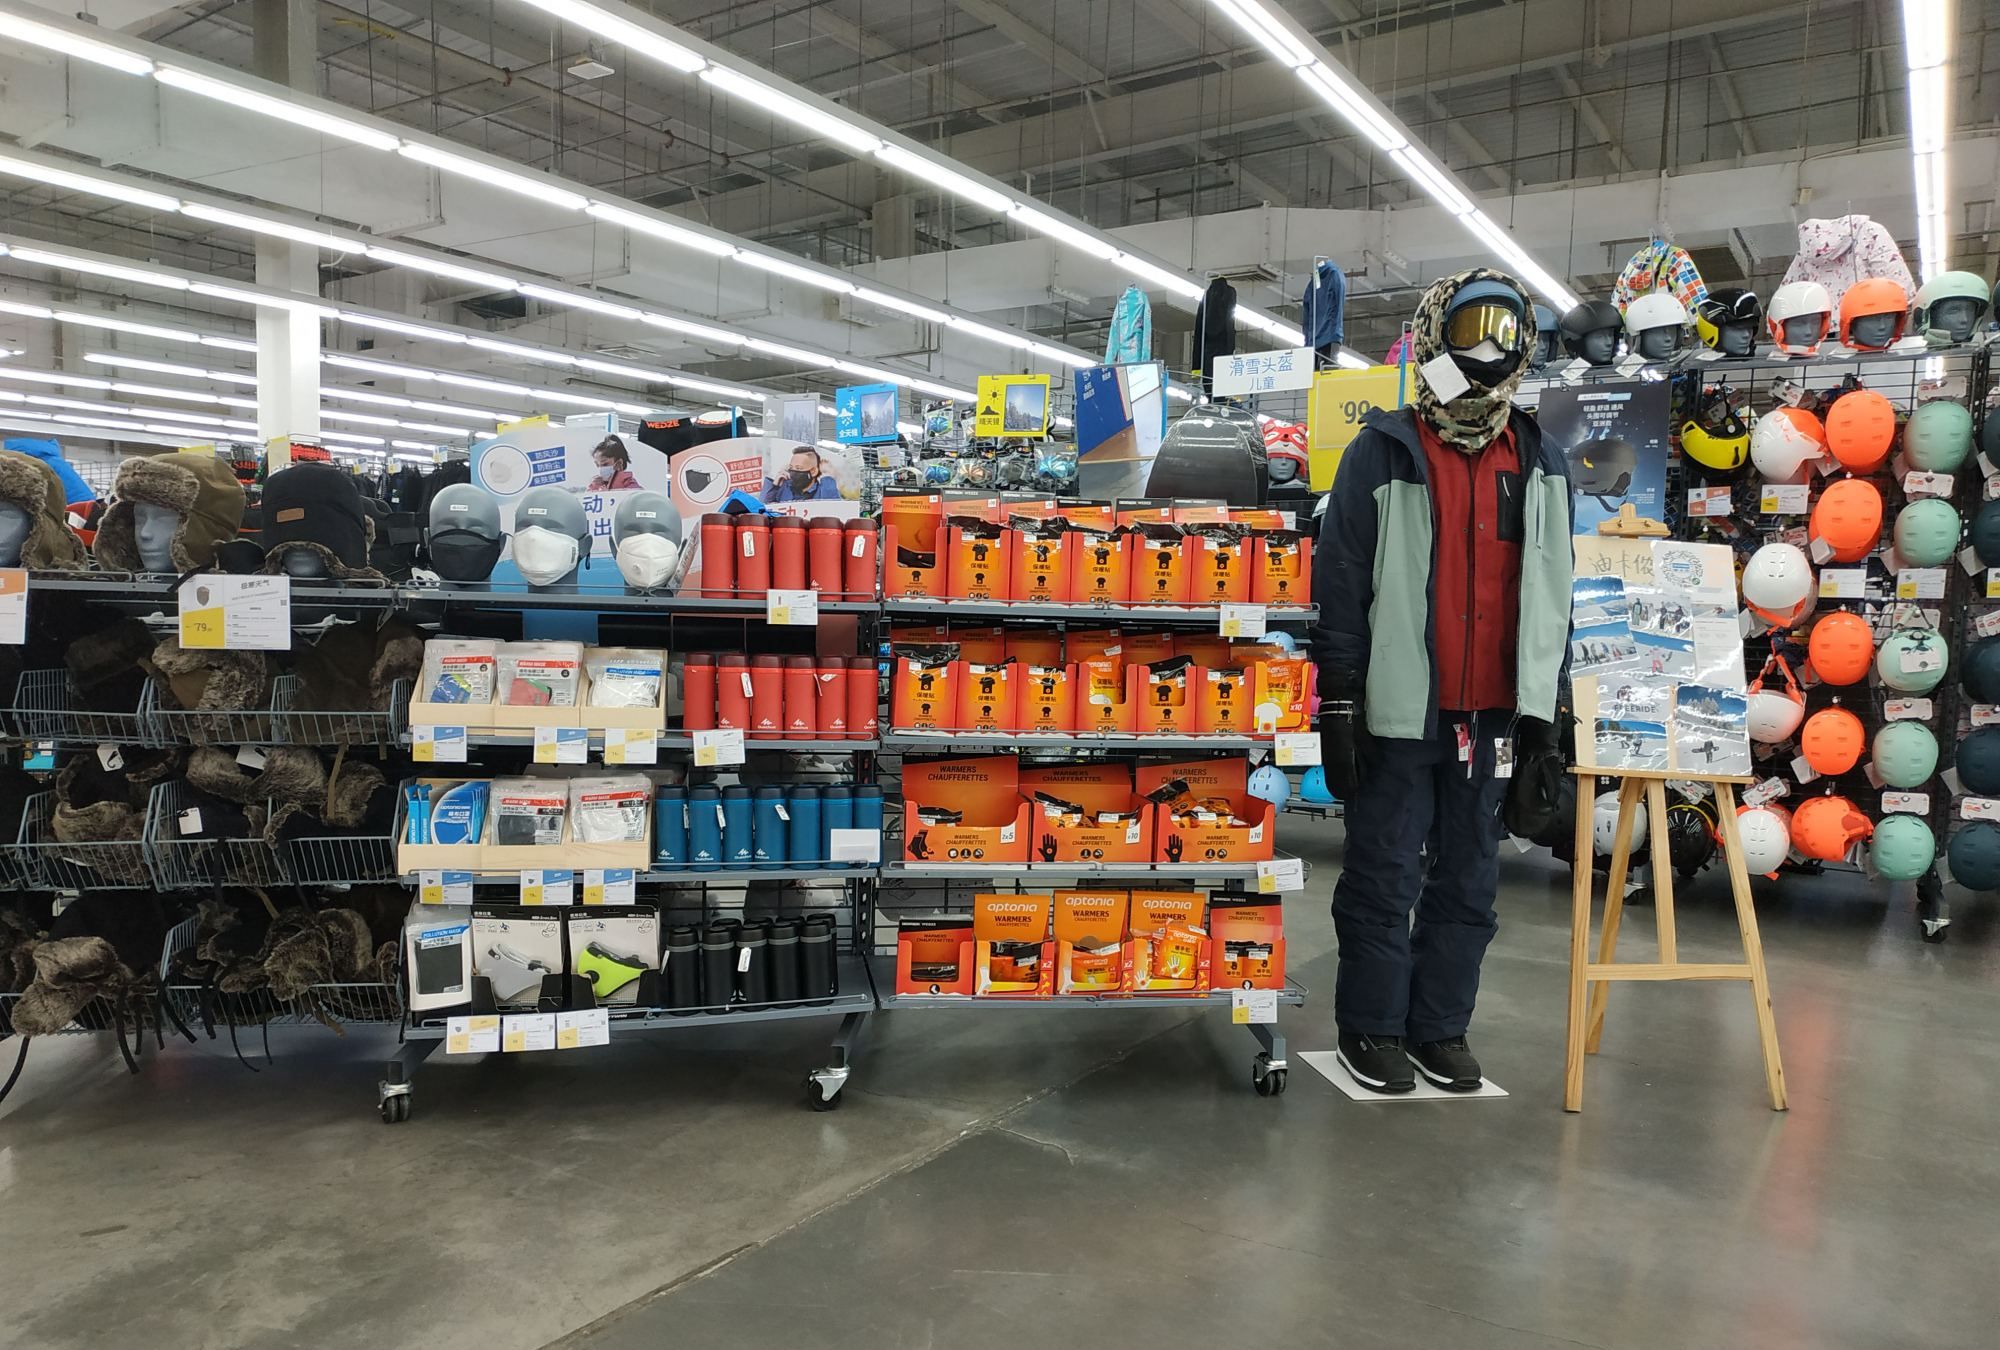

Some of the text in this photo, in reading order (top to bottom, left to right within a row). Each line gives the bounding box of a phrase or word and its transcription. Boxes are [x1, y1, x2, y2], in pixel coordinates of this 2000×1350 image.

[1230, 355, 1293, 377] 滑雪头盔
[1250, 376, 1275, 391] 儿童
[646, 419, 680, 429] WEDZE
[1290, 703, 1303, 711] x10
[1614, 703, 1657, 714] FREERIDE
[939, 765, 977, 773] WARMERS
[1172, 768, 1208, 776] WARMERS
[927, 773, 989, 782] CHAUFFERETTES
[1065, 895, 1115, 907] aptonia
[1143, 899, 1193, 910] aptonia
[986, 902, 1038, 913] aptonia
[994, 915, 1032, 923] WARMERS
[1149, 912, 1187, 921] WARMERS
[1041, 961, 1053, 969] x2
[1123, 960, 1133, 968] x2
